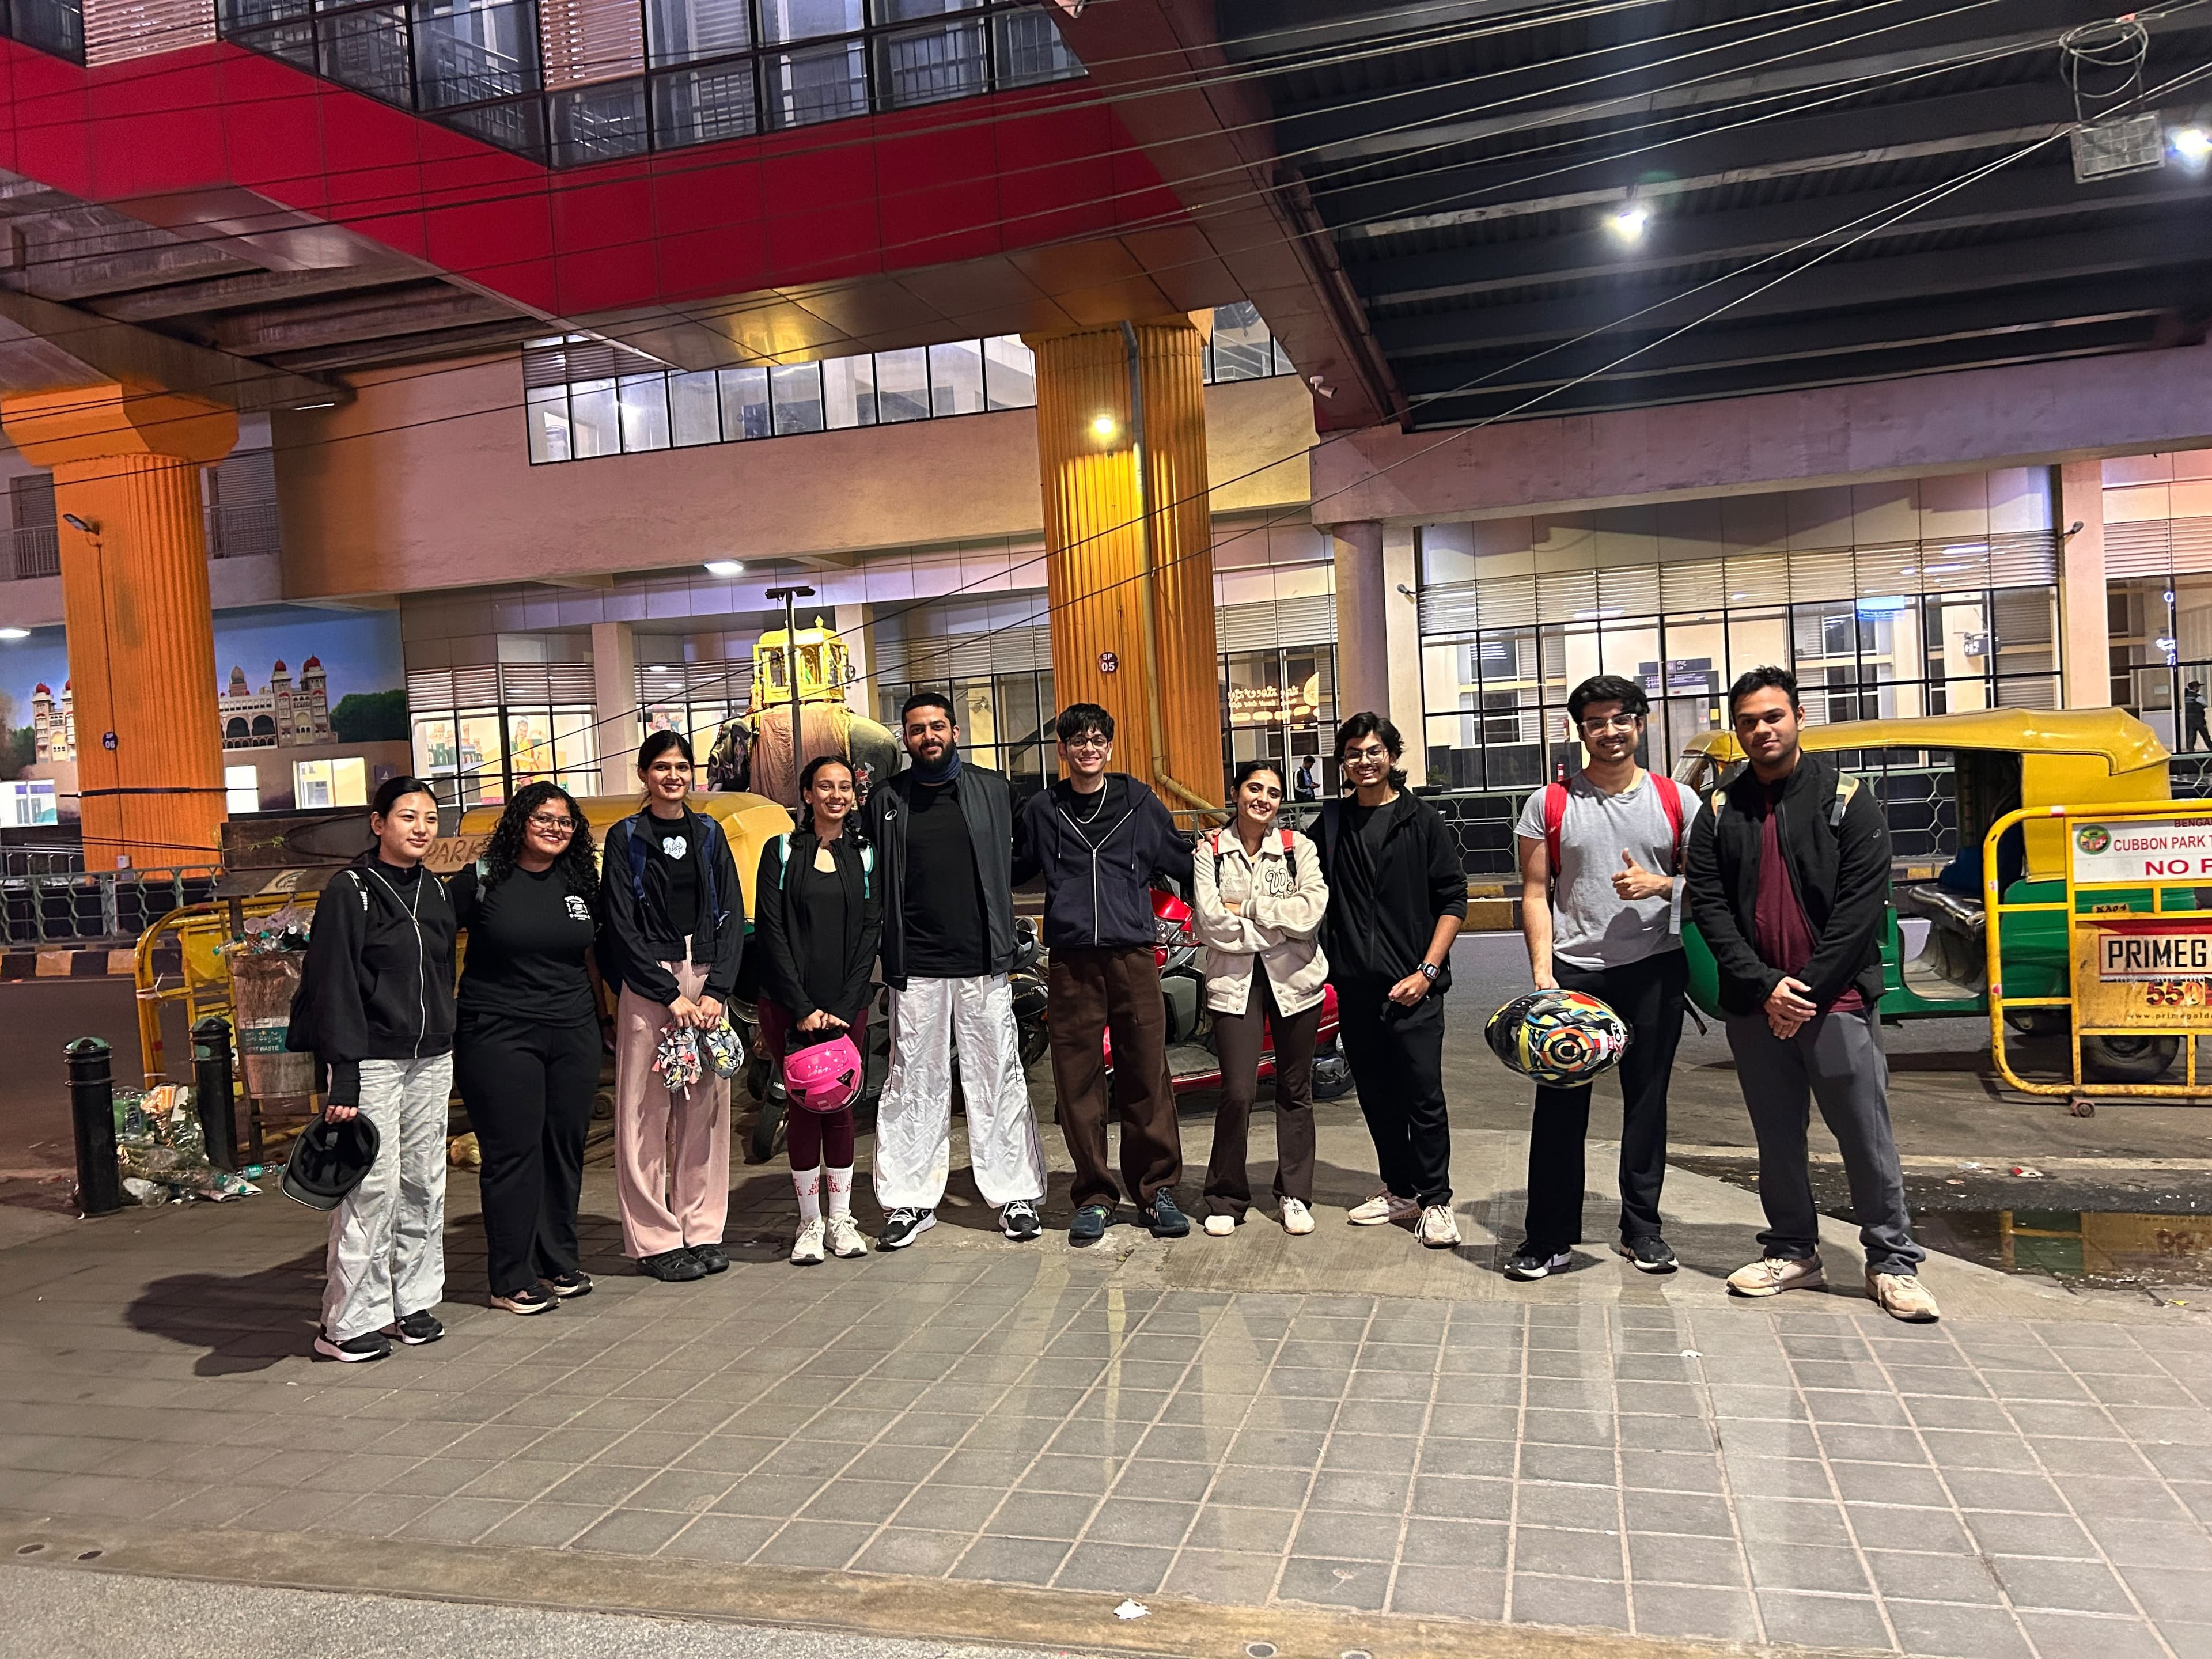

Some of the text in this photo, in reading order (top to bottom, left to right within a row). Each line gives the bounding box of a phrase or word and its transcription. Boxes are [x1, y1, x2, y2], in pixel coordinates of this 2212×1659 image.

[1101, 662, 1115, 672] 05
[105, 740, 116, 748] 06
[2174, 819, 2212, 828] BENGA
[2113, 838, 2168, 851] CUBBON
[2172, 835, 2206, 849] PARK
[2145, 859, 2190, 876] NO
[2108, 939, 2212, 968] PRIMEG
[2128, 1012, 2212, 1020] www.primegold
